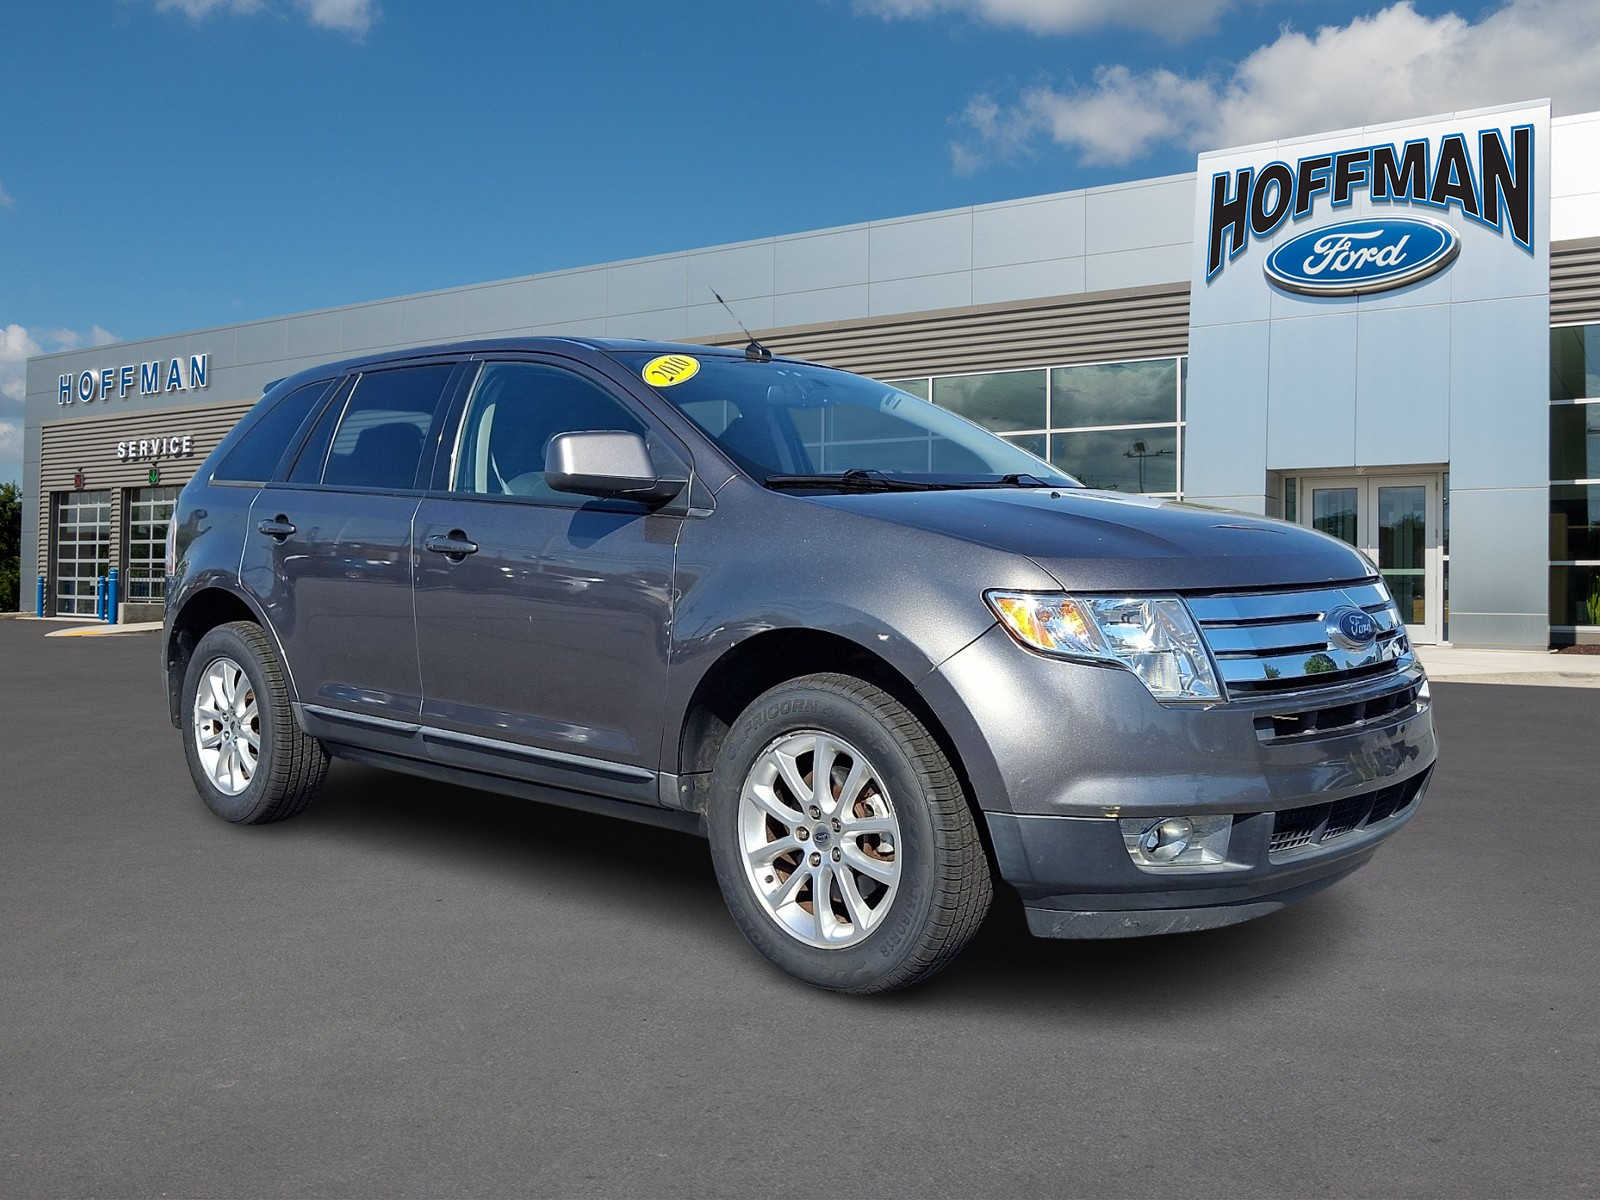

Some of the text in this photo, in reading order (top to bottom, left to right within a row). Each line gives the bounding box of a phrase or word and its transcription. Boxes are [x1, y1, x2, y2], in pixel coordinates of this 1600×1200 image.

[1206, 123, 1535, 281] HOFFMAN
[1302, 229, 1408, 275] Ford
[58, 354, 208, 405] HOFFMAN
[651, 356, 690, 382] 2010
[117, 436, 192, 458] SERVICE
[1349, 615, 1372, 636] Ford
